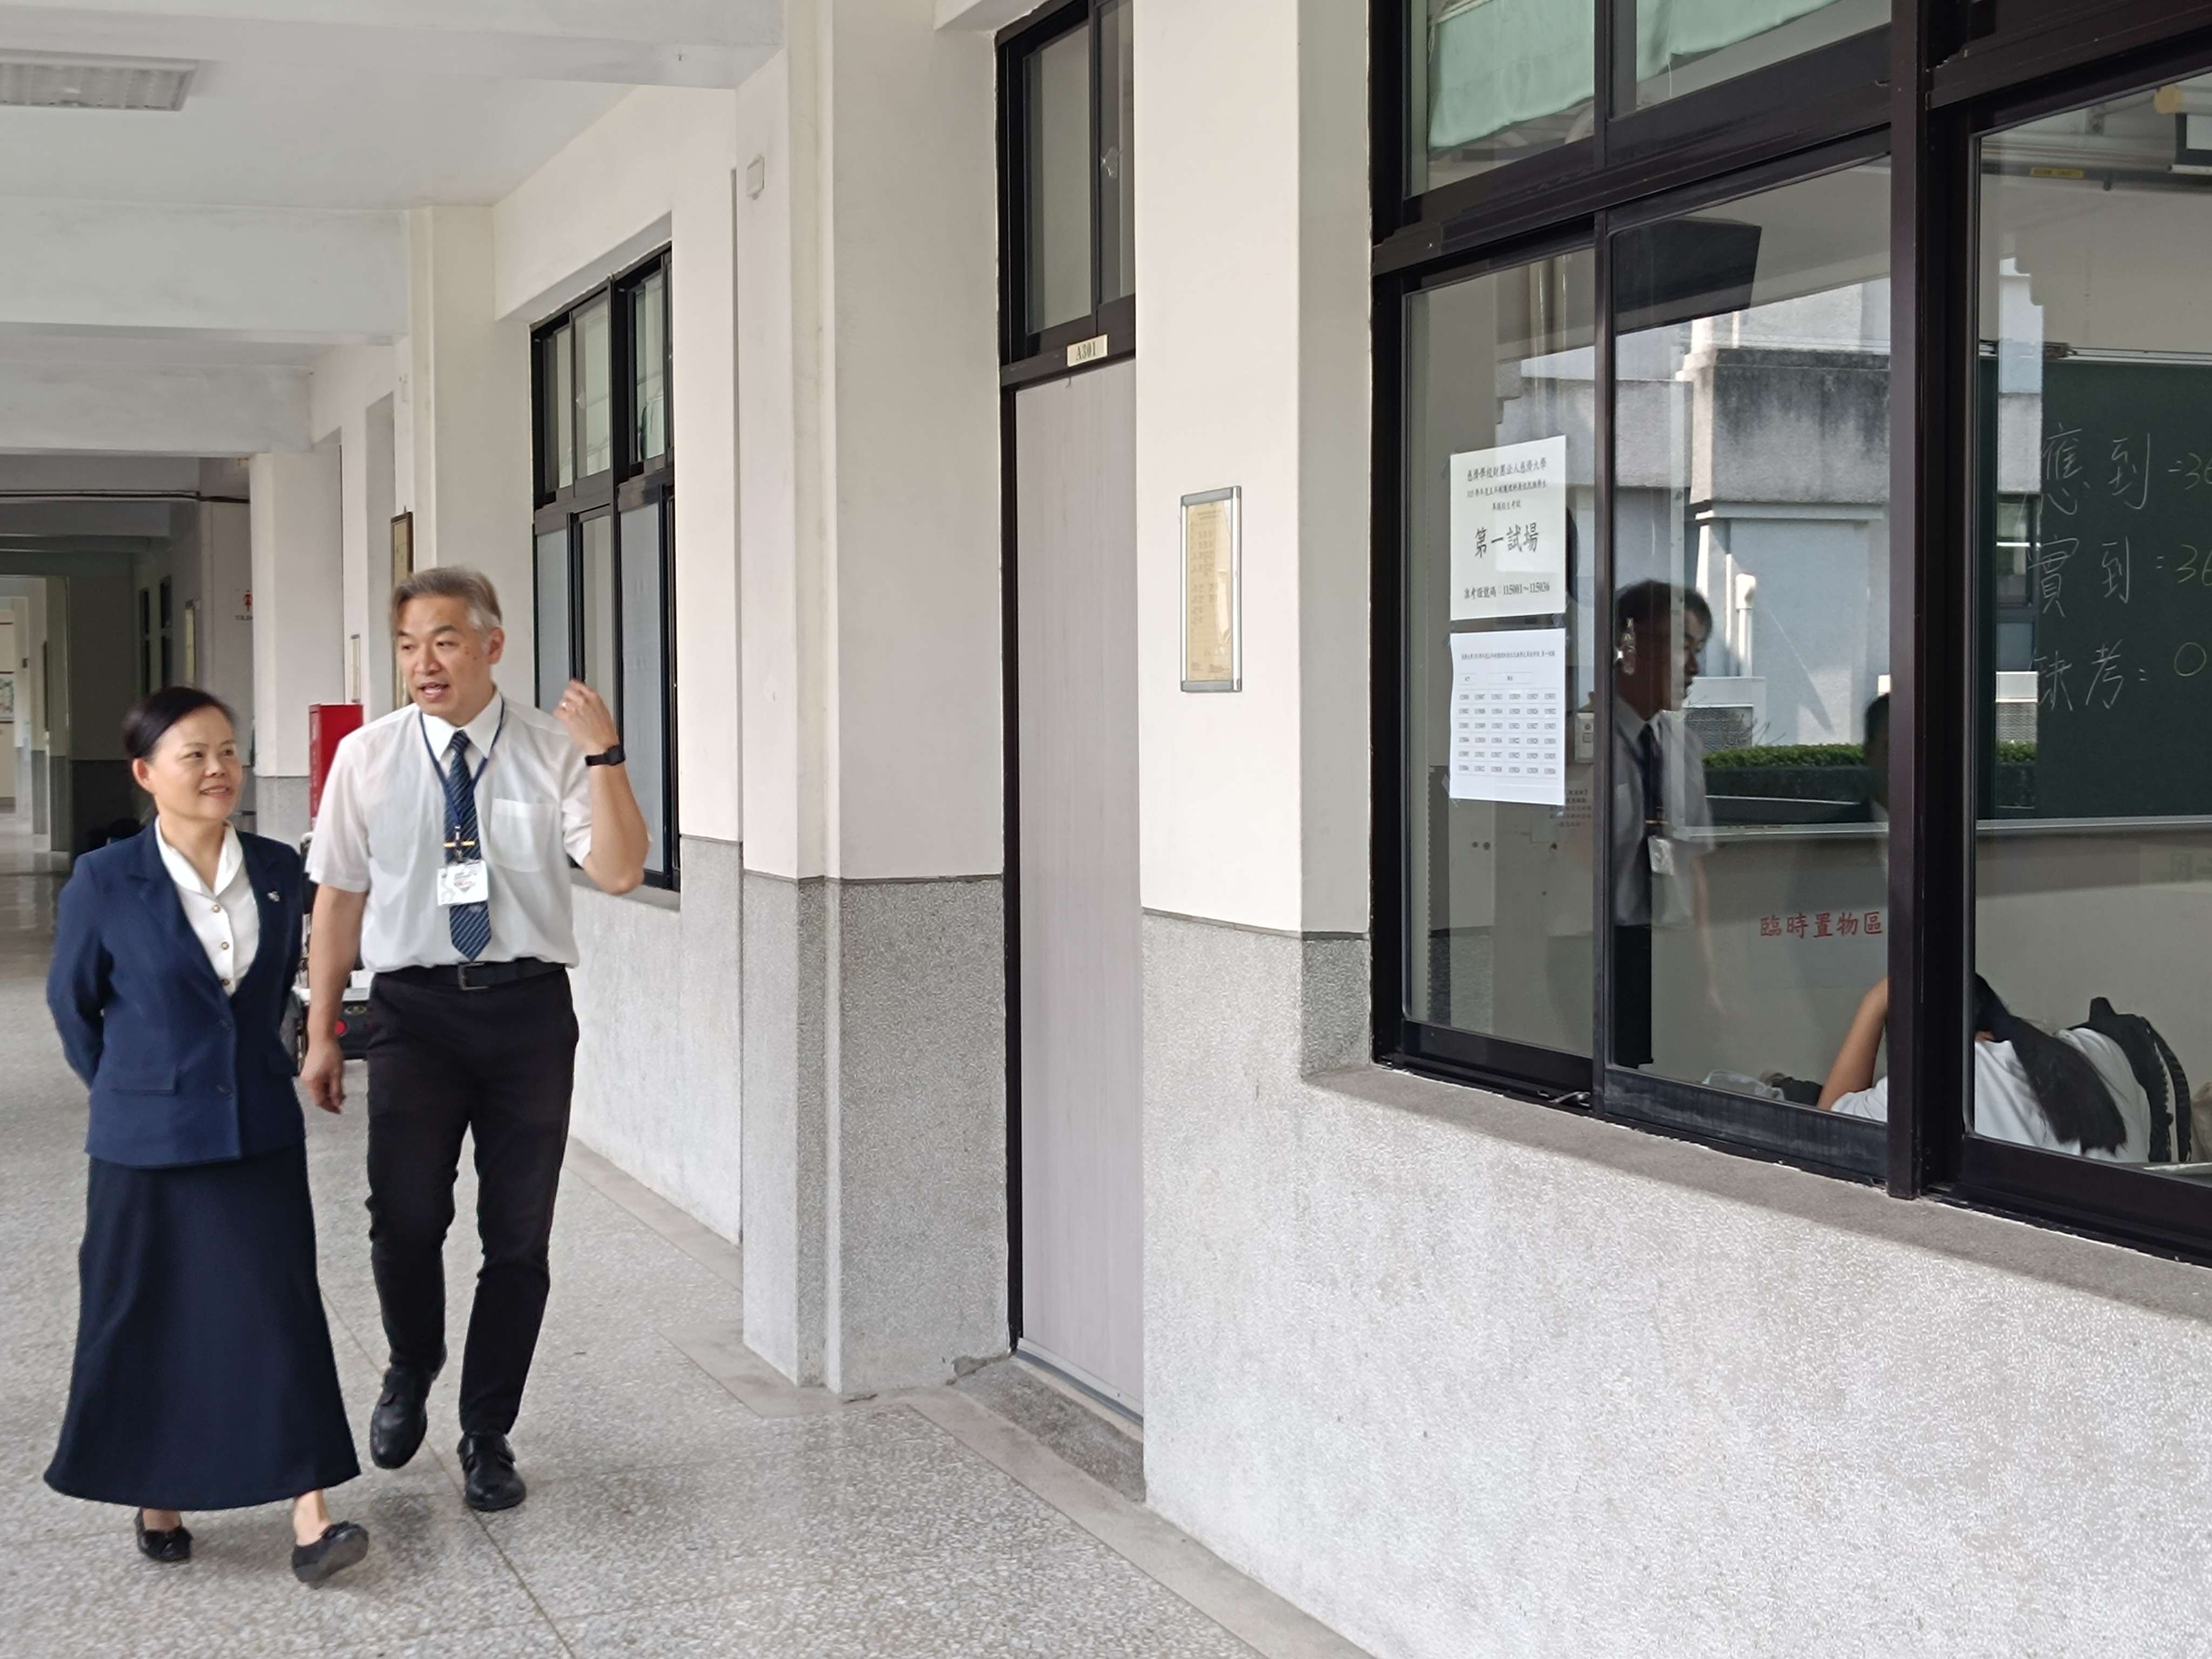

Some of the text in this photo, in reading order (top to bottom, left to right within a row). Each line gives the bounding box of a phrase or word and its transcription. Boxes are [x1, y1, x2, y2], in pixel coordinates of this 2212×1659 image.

[1475, 522, 1539, 558] 第一試場
[1760, 911, 1883, 939] 臨時置物區
